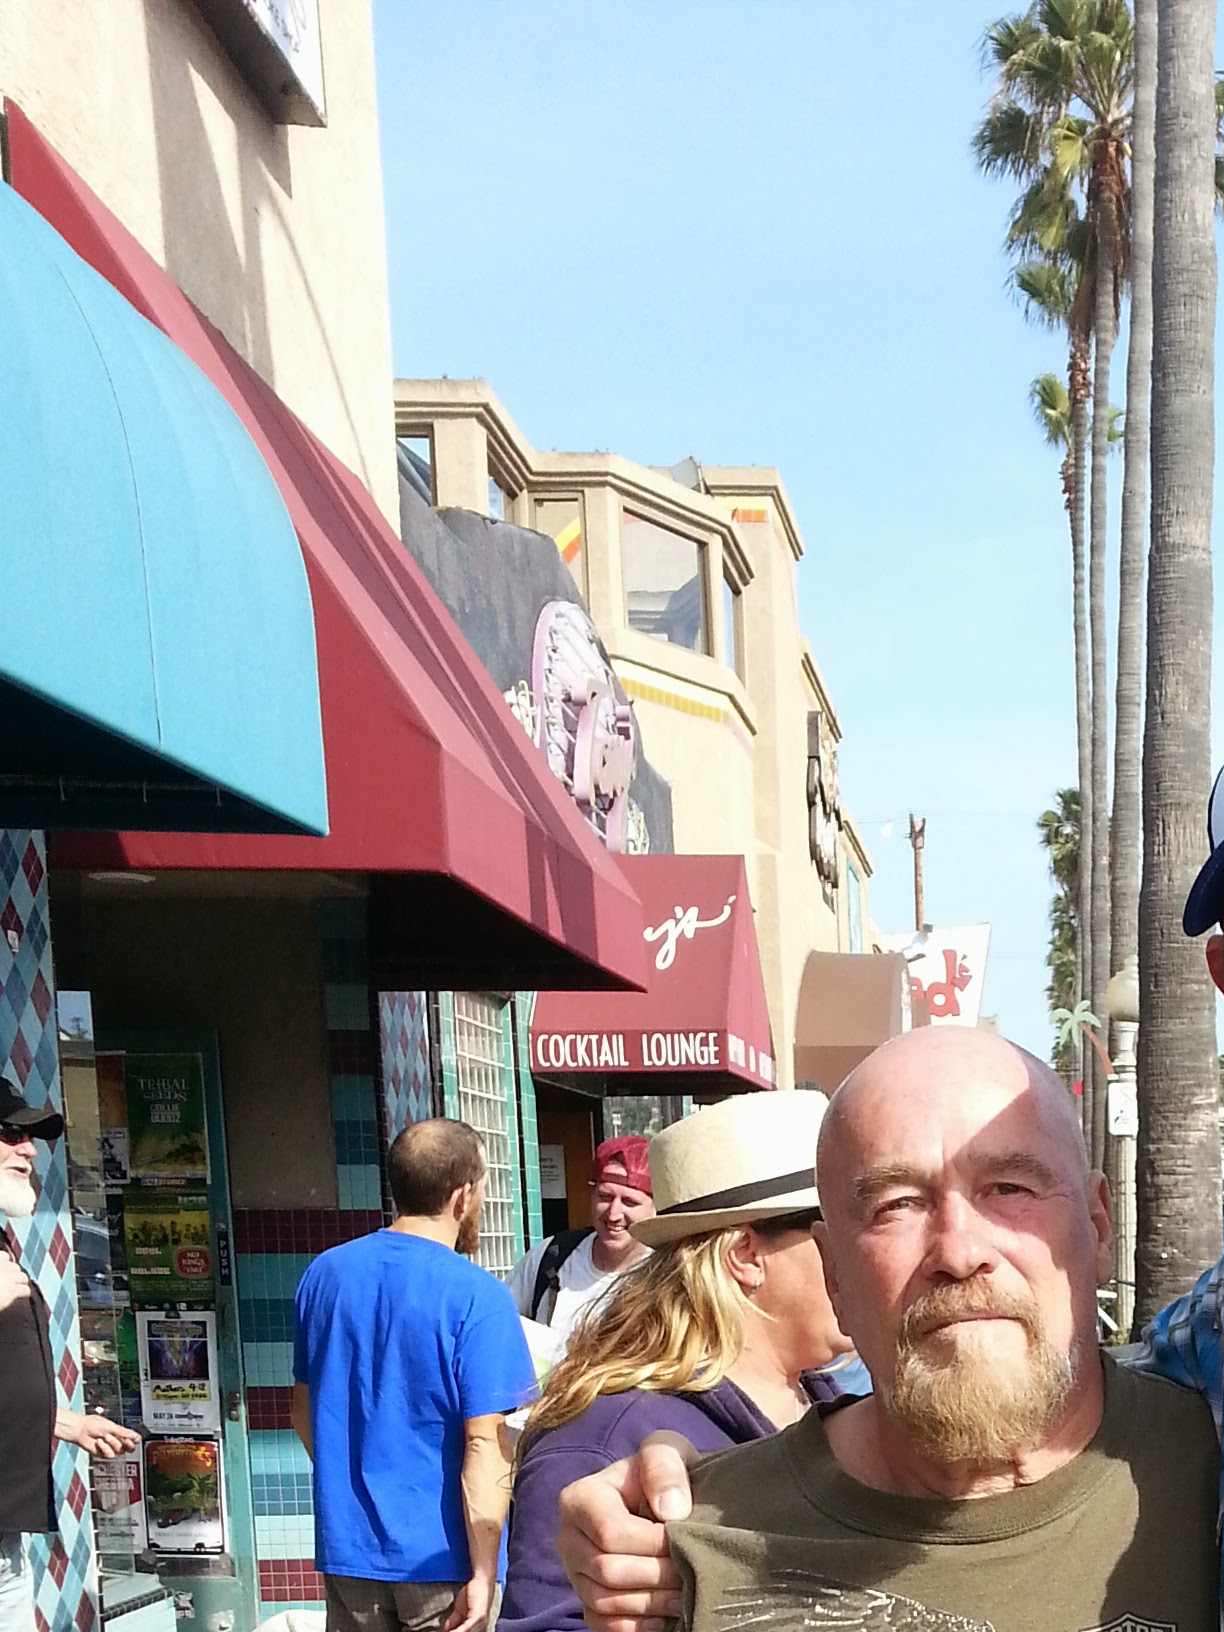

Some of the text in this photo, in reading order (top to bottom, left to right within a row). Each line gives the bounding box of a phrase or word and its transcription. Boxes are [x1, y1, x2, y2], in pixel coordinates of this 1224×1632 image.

[536, 1033, 630, 1068] COCKTAIL
[641, 1031, 720, 1067] LOUNGE
[137, 1078, 190, 1091] TRIBAL
[219, 1240, 229, 1276] PUSH
